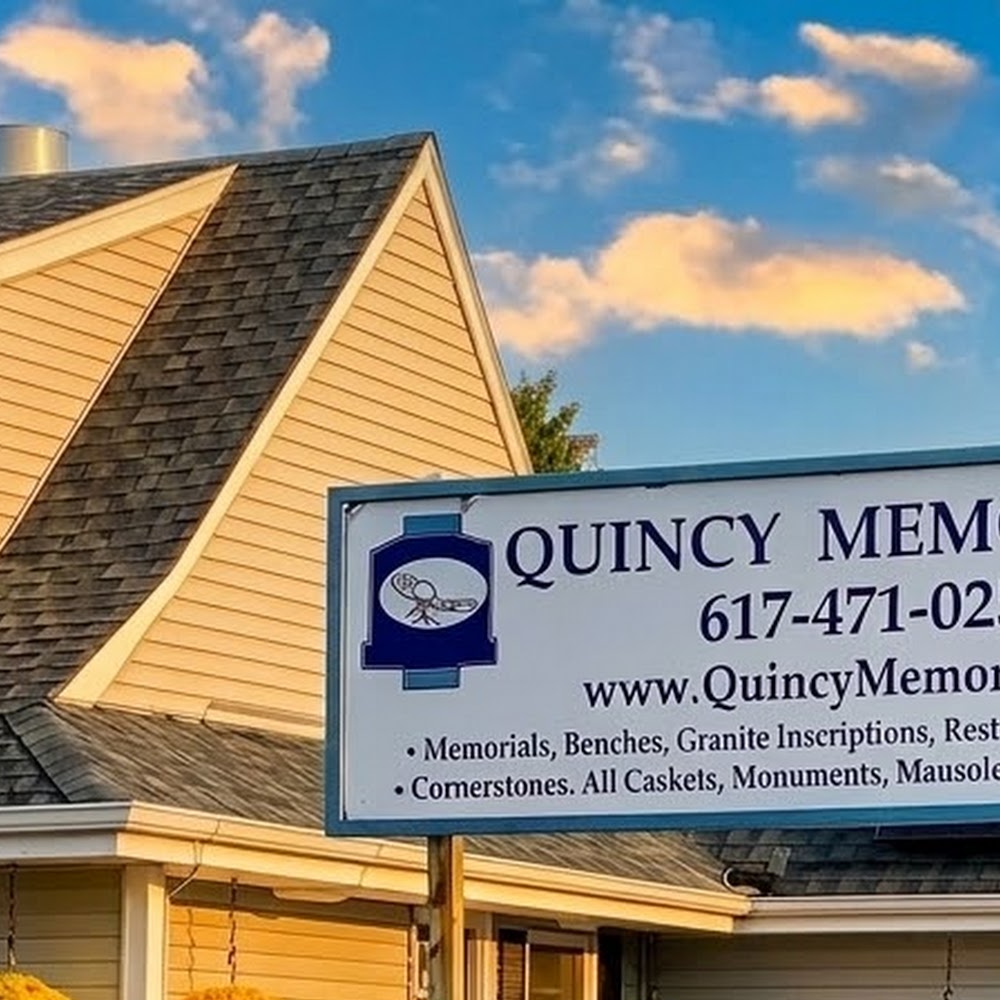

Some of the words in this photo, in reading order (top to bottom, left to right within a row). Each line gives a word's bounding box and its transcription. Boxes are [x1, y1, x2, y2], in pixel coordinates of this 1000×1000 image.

[505, 511, 781, 590] QUINCY
[817, 498, 1000, 562] MEM
[700, 579, 1000, 643] 617-471-02
[423, 732, 557, 762] Memorials,
[564, 729, 669, 757] Benches,
[677, 724, 770, 752] Granite
[777, 720, 936, 754] Inscriptions,
[411, 775, 575, 800] Cornerstones.
[581, 768, 617, 794] All
[624, 766, 724, 795] Caskets,
[732, 763, 888, 790] Monuments,
